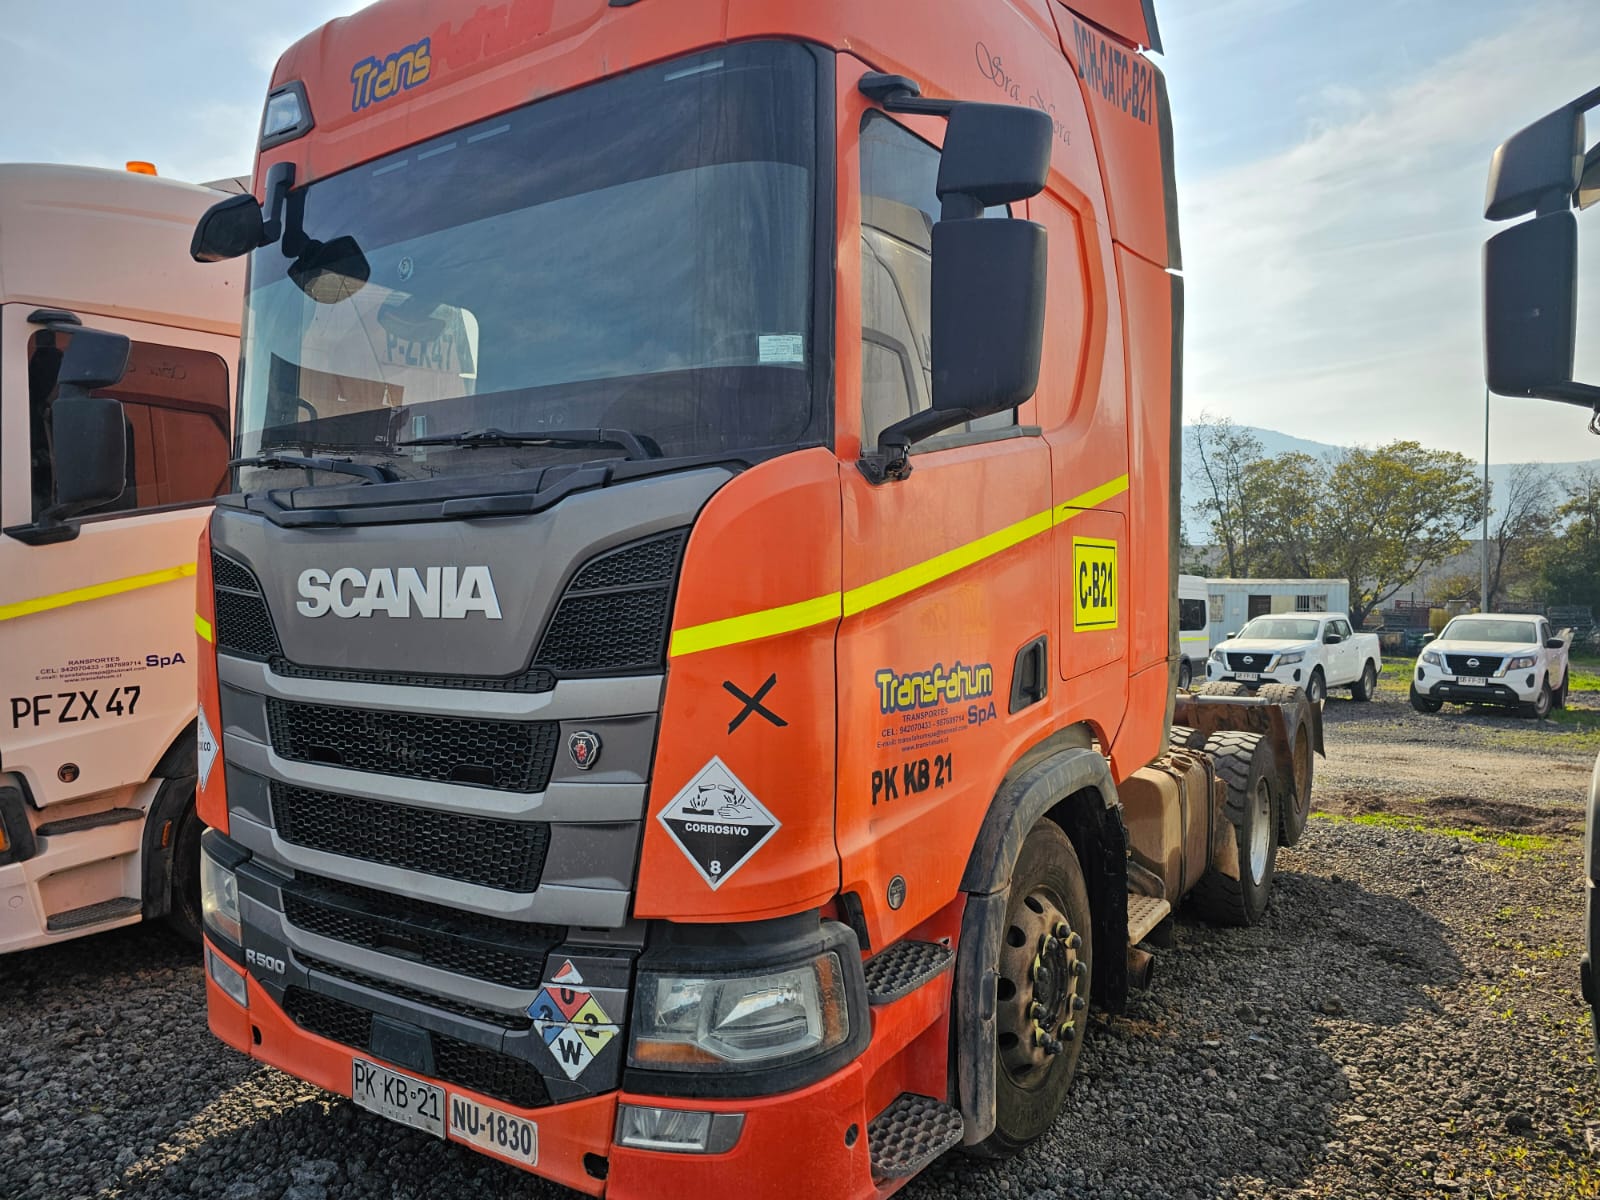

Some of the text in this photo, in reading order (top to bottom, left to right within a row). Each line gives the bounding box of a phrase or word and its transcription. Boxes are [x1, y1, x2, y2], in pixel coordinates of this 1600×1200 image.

[351, 37, 431, 112] Trans
[1073, 19, 1153, 125] DCH-CATC-B21
[296, 565, 503, 619] SCANIA
[1079, 561, 1113, 609] C-B21
[40, 667, 60, 675] CEL:
[145, 652, 186, 669] SpA
[875, 661, 993, 714] Transfahum
[10, 685, 141, 728] PF ZX 47
[903, 707, 949, 723] TRANSPORTES
[968, 701, 997, 726] SpA
[881, 728, 898, 738] CEL:
[871, 752, 952, 806] PK KB 21
[684, 822, 750, 837] CORROSIVO
[710, 860, 722, 875] 8
[558, 1037, 583, 1066] W
[452, 1098, 533, 1156] NU-1830
